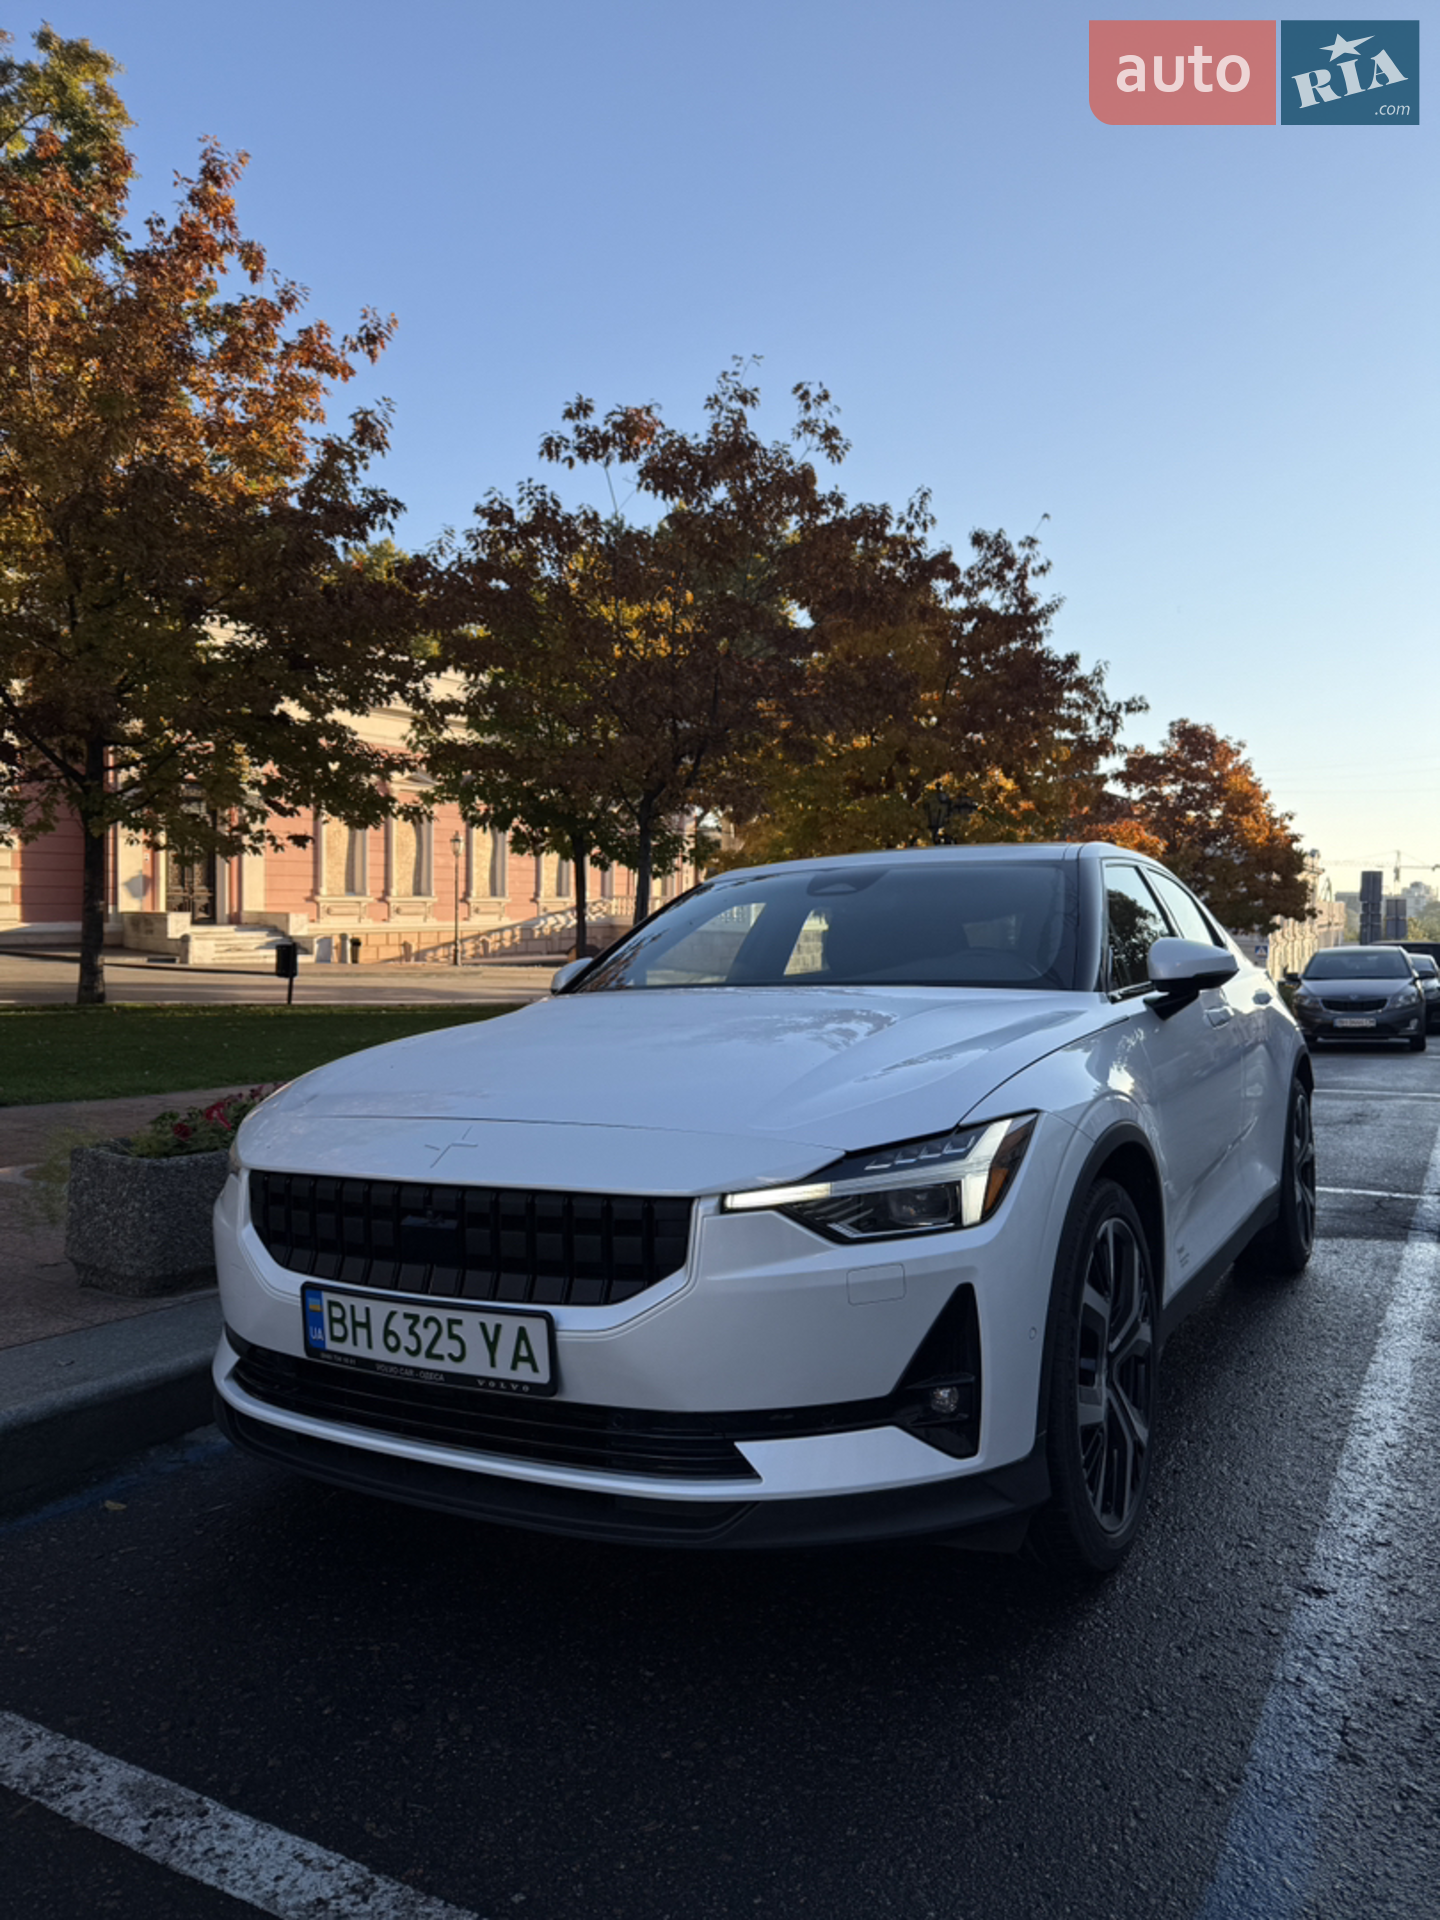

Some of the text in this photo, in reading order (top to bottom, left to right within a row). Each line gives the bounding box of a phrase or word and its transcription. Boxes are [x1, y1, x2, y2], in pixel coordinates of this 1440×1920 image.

[309, 1326, 325, 1341] UA
[327, 1300, 540, 1374] BH 6325 YA
[476, 1379, 531, 1393] VOLVO
